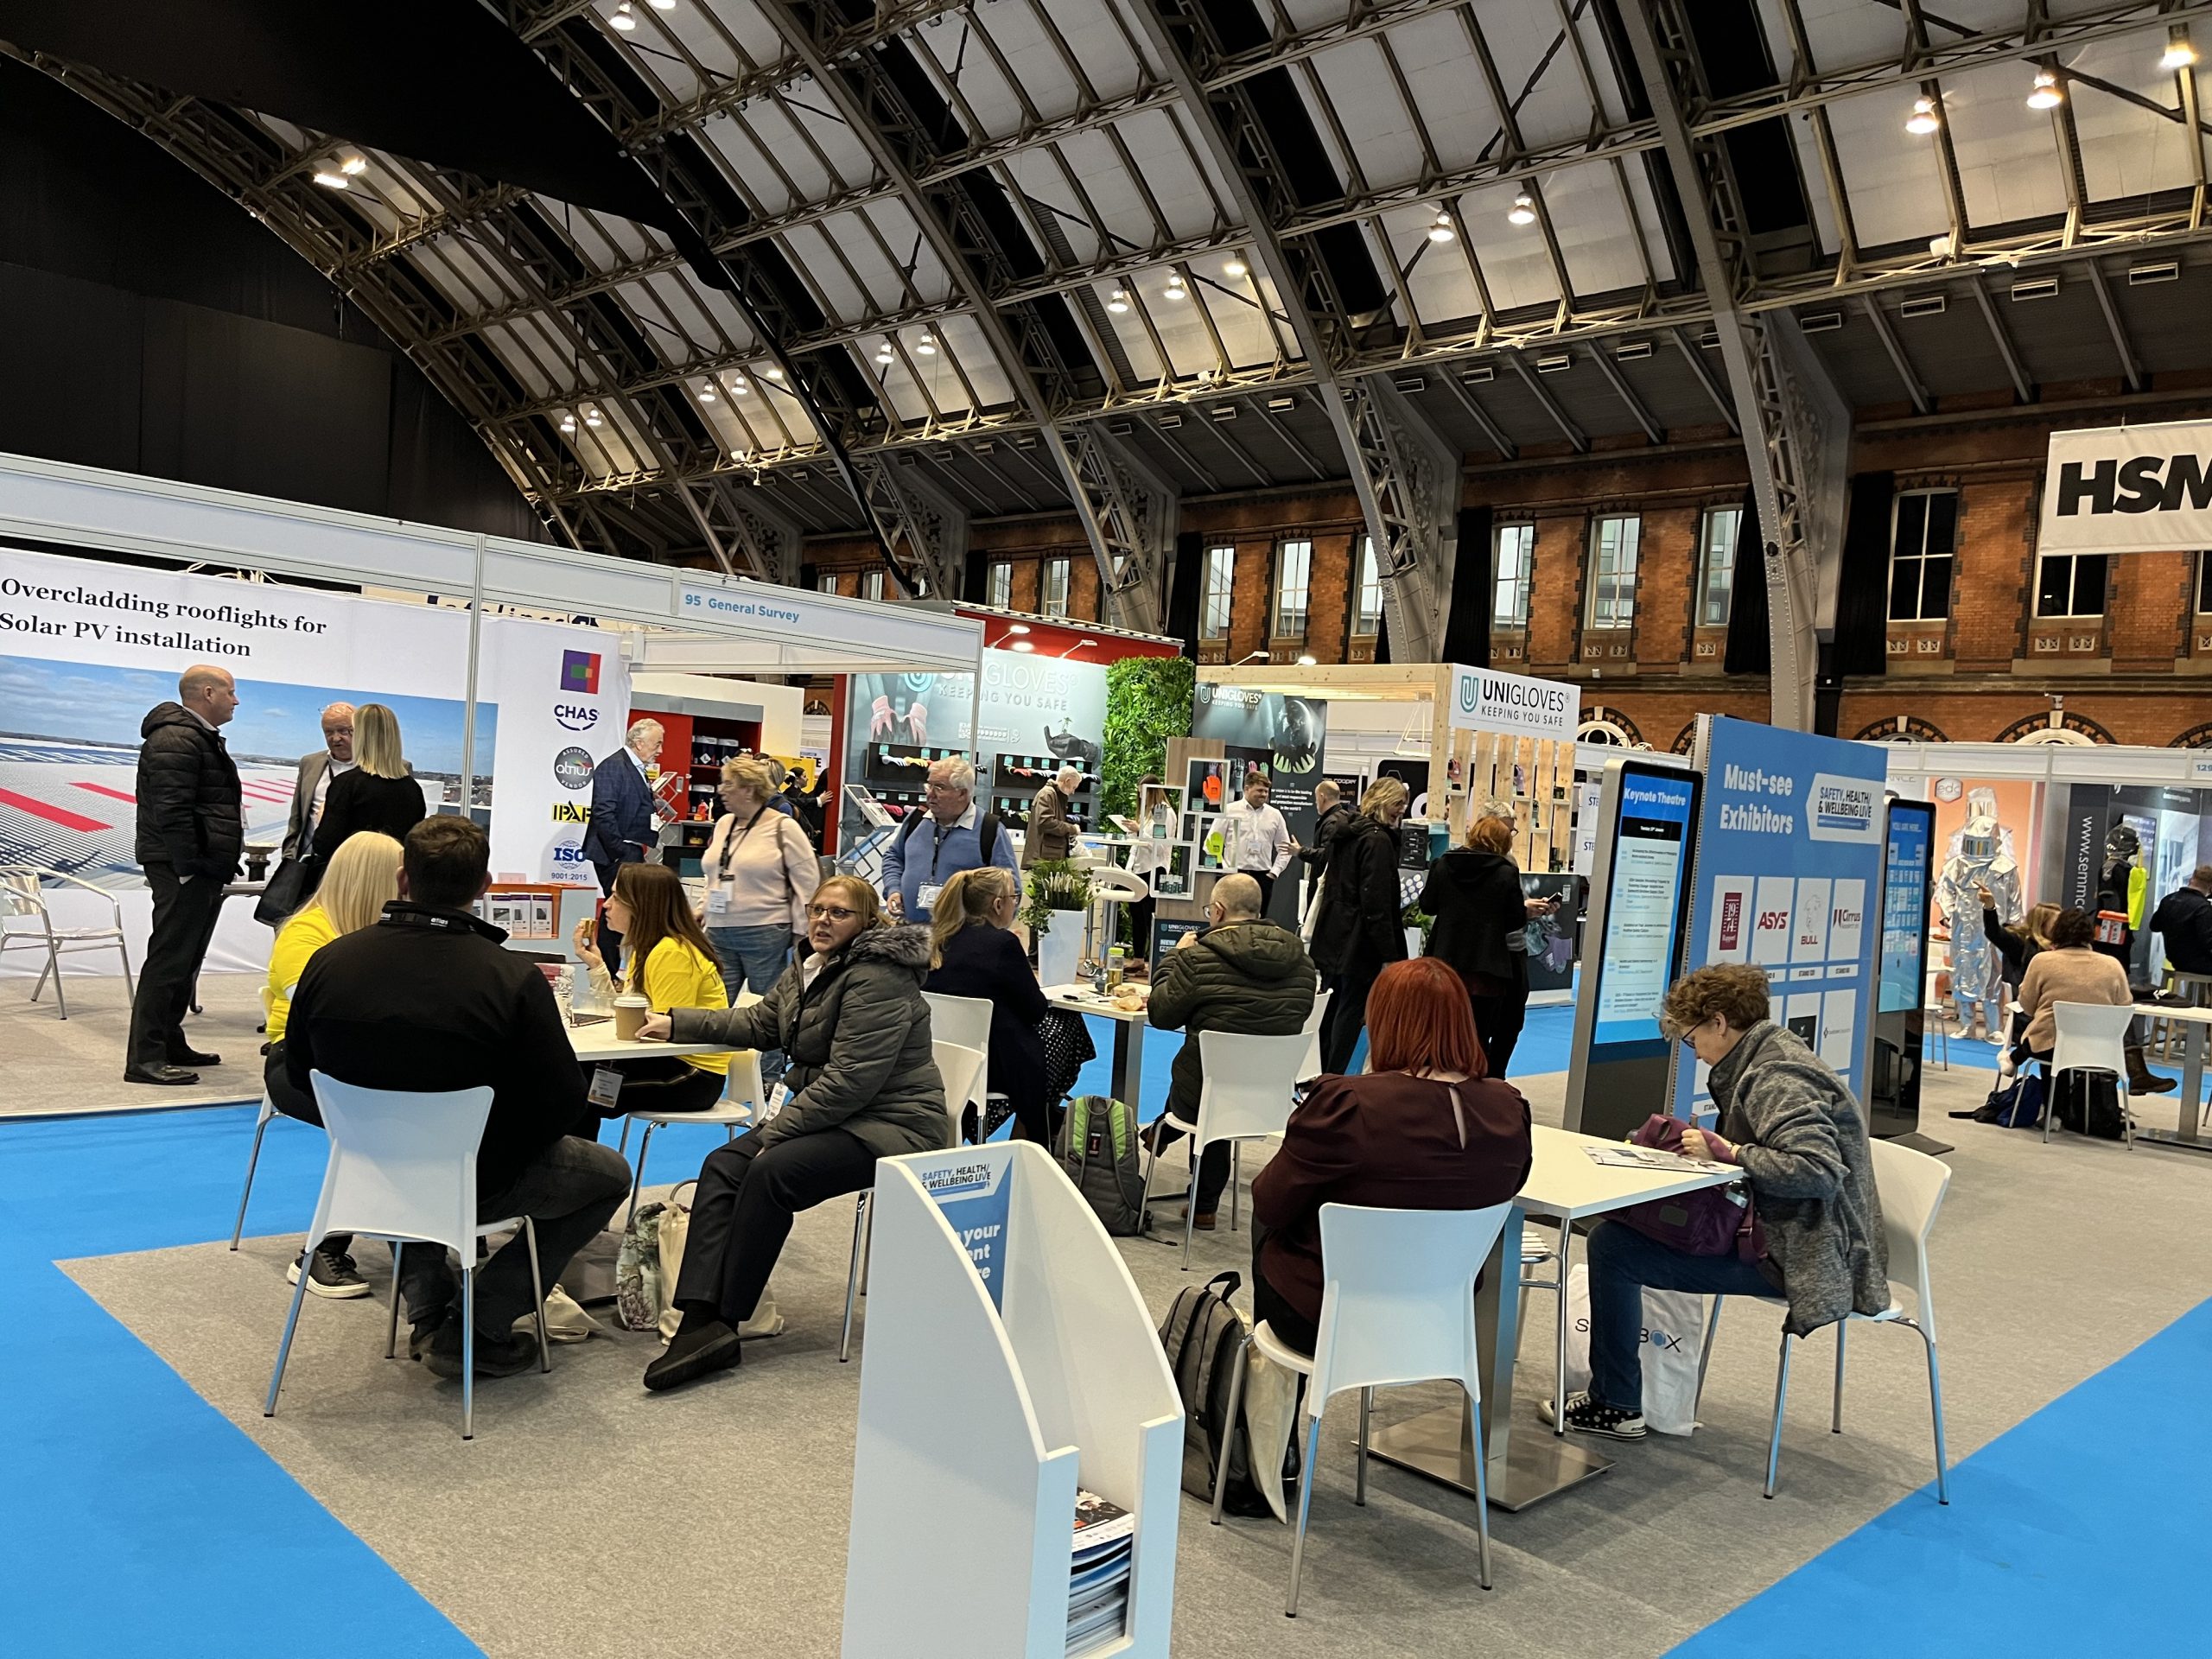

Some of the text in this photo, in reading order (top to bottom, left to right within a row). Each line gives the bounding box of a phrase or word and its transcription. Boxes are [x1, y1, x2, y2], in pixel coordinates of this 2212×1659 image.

[1, 578, 328, 635] Overcladding rooflights for
[685, 594, 800, 623] 95 General Survey
[0, 613, 252, 657] Solar PV installation
[938, 683, 1068, 711] KEEPNG YOU SAFE
[1483, 678, 1564, 712] UNIGLOVES
[554, 704, 598, 721] CHAS
[1481, 705, 1519, 721] KEEPING
[1522, 711, 1540, 723] YOU
[1543, 715, 1563, 727] SAFE
[563, 747, 589, 759] ASSURED
[1724, 763, 1793, 797] Must-see
[1624, 787, 1686, 806] Keynote Theatre
[1719, 803, 1794, 835] Exhibitors
[1825, 801, 1859, 817] WELLBEING
[1859, 804, 1872, 818] LIVE
[553, 848, 588, 862] ISO
[1758, 912, 1789, 930] ASYS
[1842, 909, 1861, 922] Cirrus
[1801, 935, 1818, 945] BULL
[929, 1174, 974, 1189] WELLBEING
[975, 1172, 991, 1182] LIVE
[963, 1224, 1001, 1247] your
